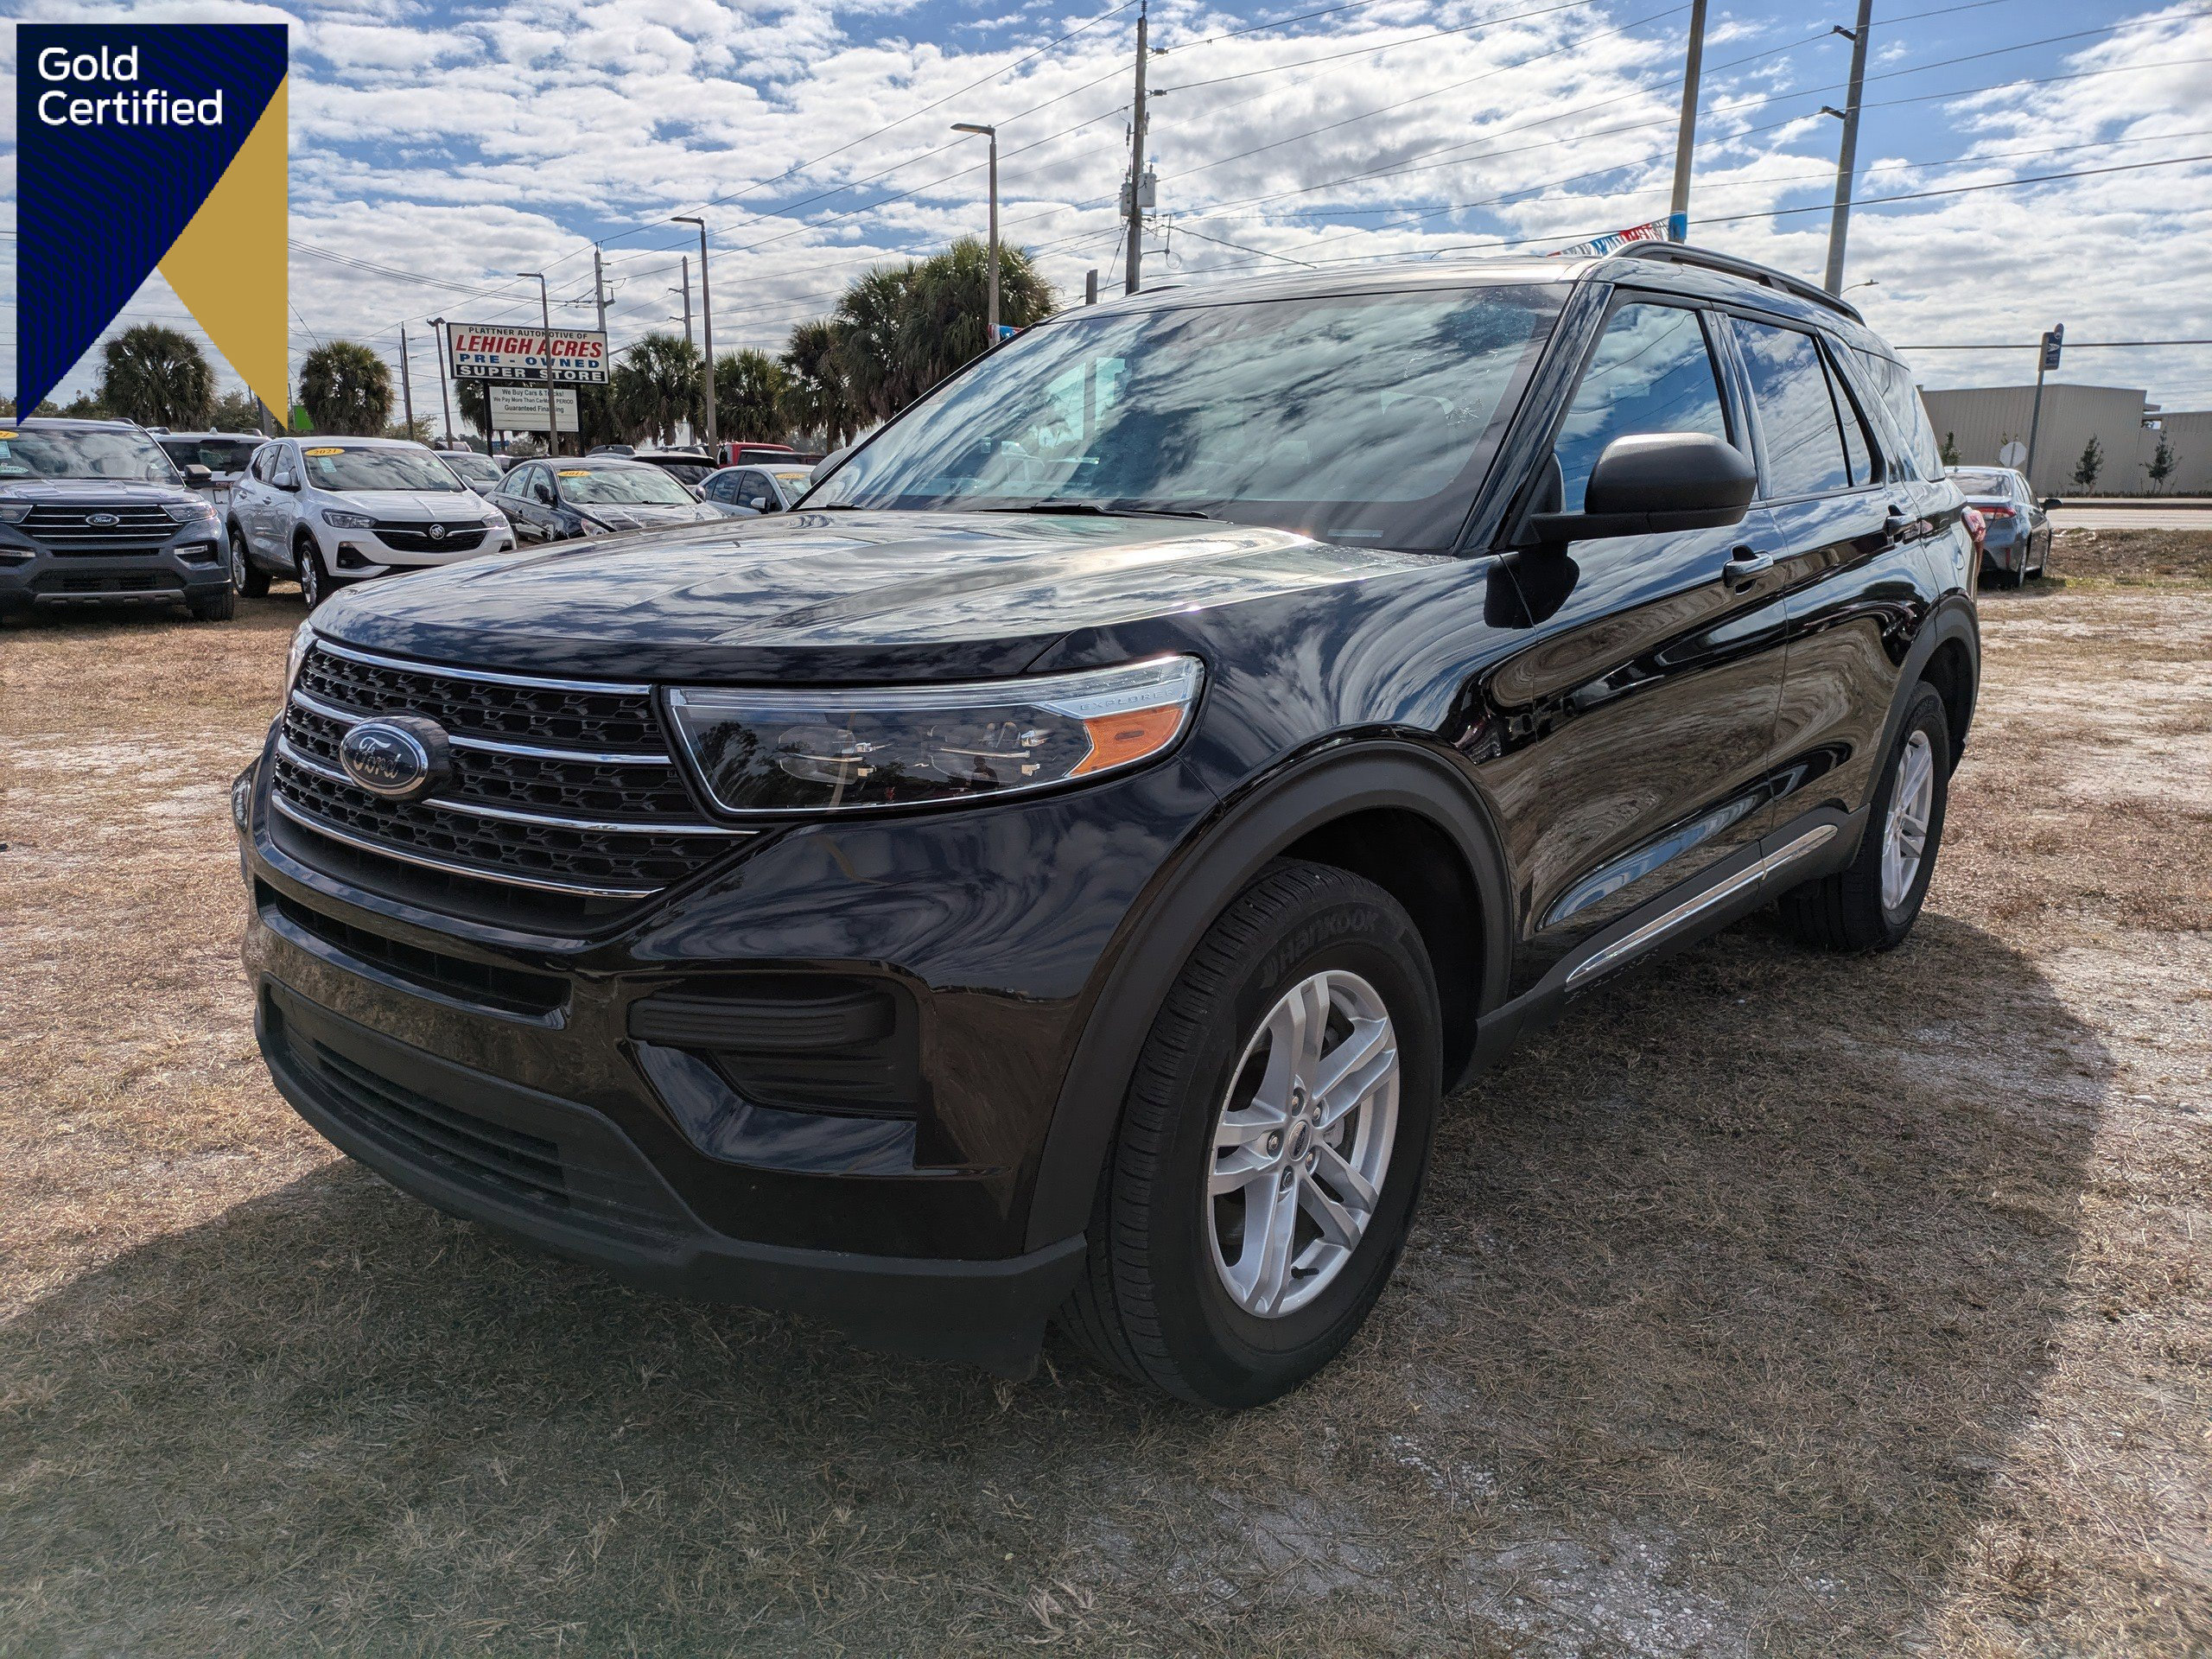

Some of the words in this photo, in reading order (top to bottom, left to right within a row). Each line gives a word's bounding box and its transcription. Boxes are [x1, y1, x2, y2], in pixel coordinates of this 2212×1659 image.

[469, 327, 514, 335] PLATTNER
[455, 334, 533, 354] LEHIGH
[537, 339, 602, 358] ACRES
[460, 365, 526, 378] SUPER
[539, 369, 602, 381] STORE
[1080, 690, 1174, 710] EXPLORER
[353, 736, 402, 779] Ford
